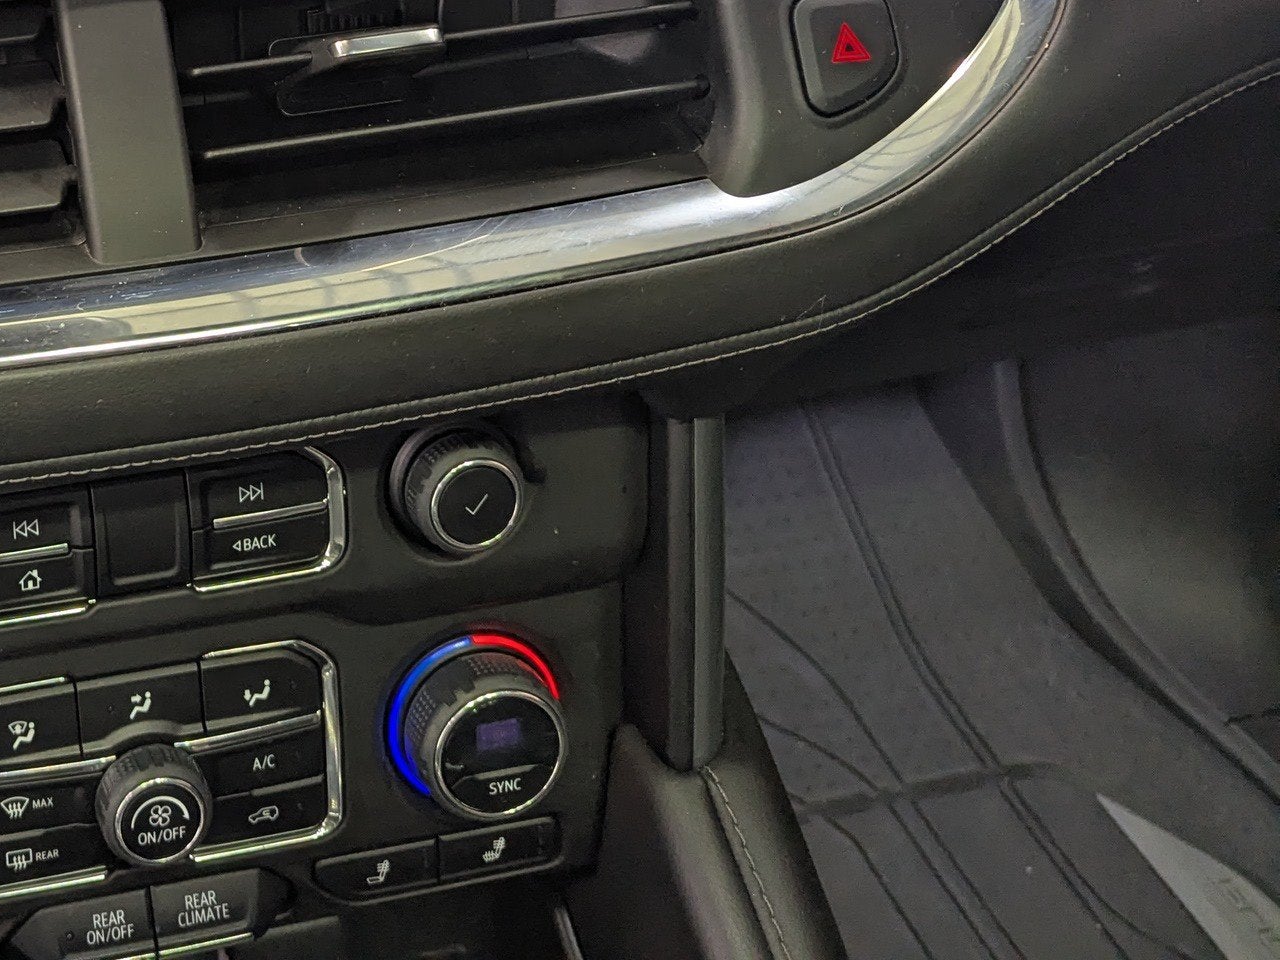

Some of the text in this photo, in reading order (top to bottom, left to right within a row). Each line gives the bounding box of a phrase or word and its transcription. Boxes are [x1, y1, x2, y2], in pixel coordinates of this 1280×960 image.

[243, 533, 277, 551] BACK
[252, 753, 276, 771] A/C
[489, 778, 522, 796] SYNC
[32, 797, 54, 810] MAX
[138, 825, 186, 846] ON/OFF
[35, 848, 60, 861] REAR
[184, 890, 217, 910] REAR
[92, 909, 126, 929] REAR
[177, 903, 231, 928] CLIMATE
[86, 923, 135, 945] ON/OFF
